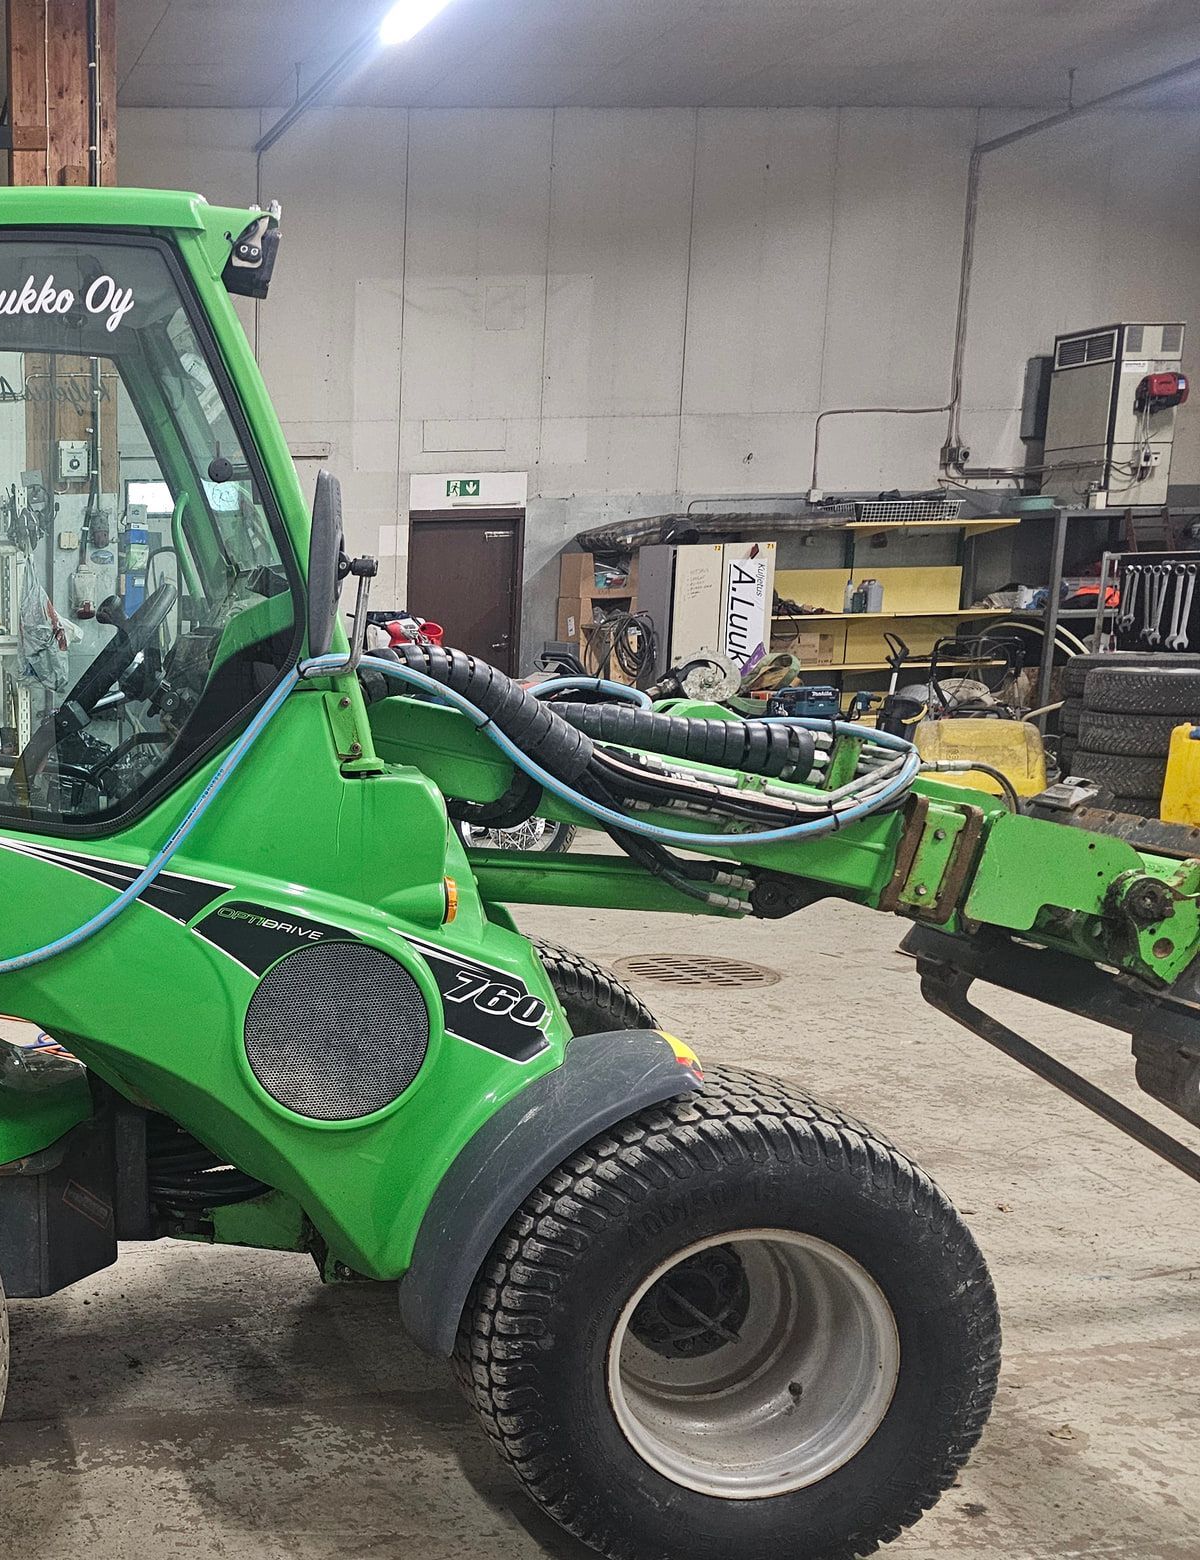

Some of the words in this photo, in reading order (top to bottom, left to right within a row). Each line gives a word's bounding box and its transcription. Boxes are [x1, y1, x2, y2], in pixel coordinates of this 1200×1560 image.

[85, 275, 135, 332] Oy
[755, 562, 766, 597] Kuljetus
[217, 907, 324, 941] OPTIDRIVE
